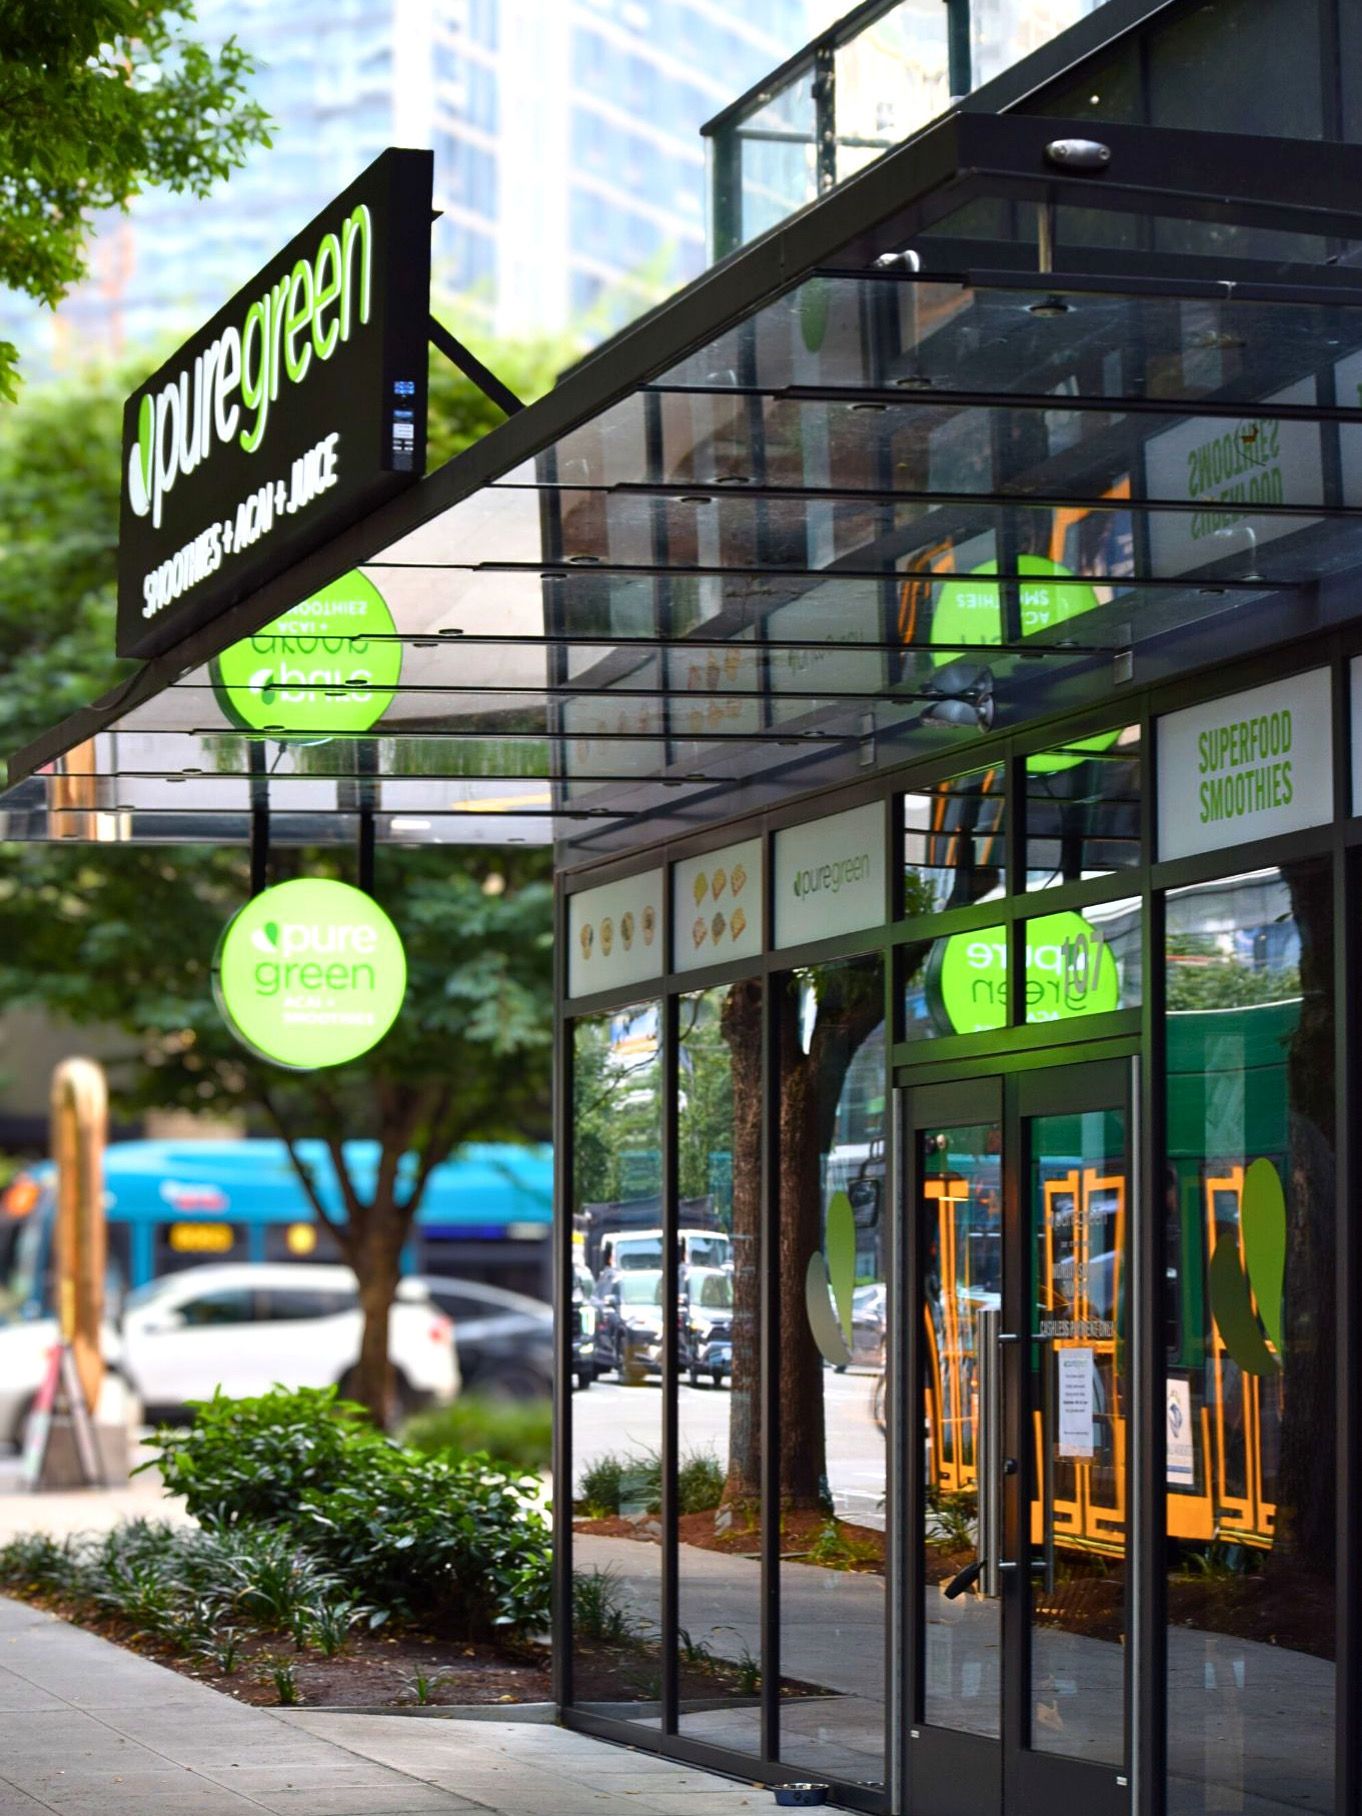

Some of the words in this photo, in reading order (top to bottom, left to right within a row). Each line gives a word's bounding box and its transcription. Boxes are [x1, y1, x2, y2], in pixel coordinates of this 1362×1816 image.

[141, 522, 222, 619] SMOOTHIES
[233, 482, 274, 554] ACAI
[286, 432, 339, 514] JUICE
[1198, 709, 1293, 775] SUPERFOOD
[1200, 760, 1293, 824] SMOOTHIES
[282, 924, 377, 958] pure
[1061, 931, 1105, 1000] 107
[255, 962, 376, 997] green
